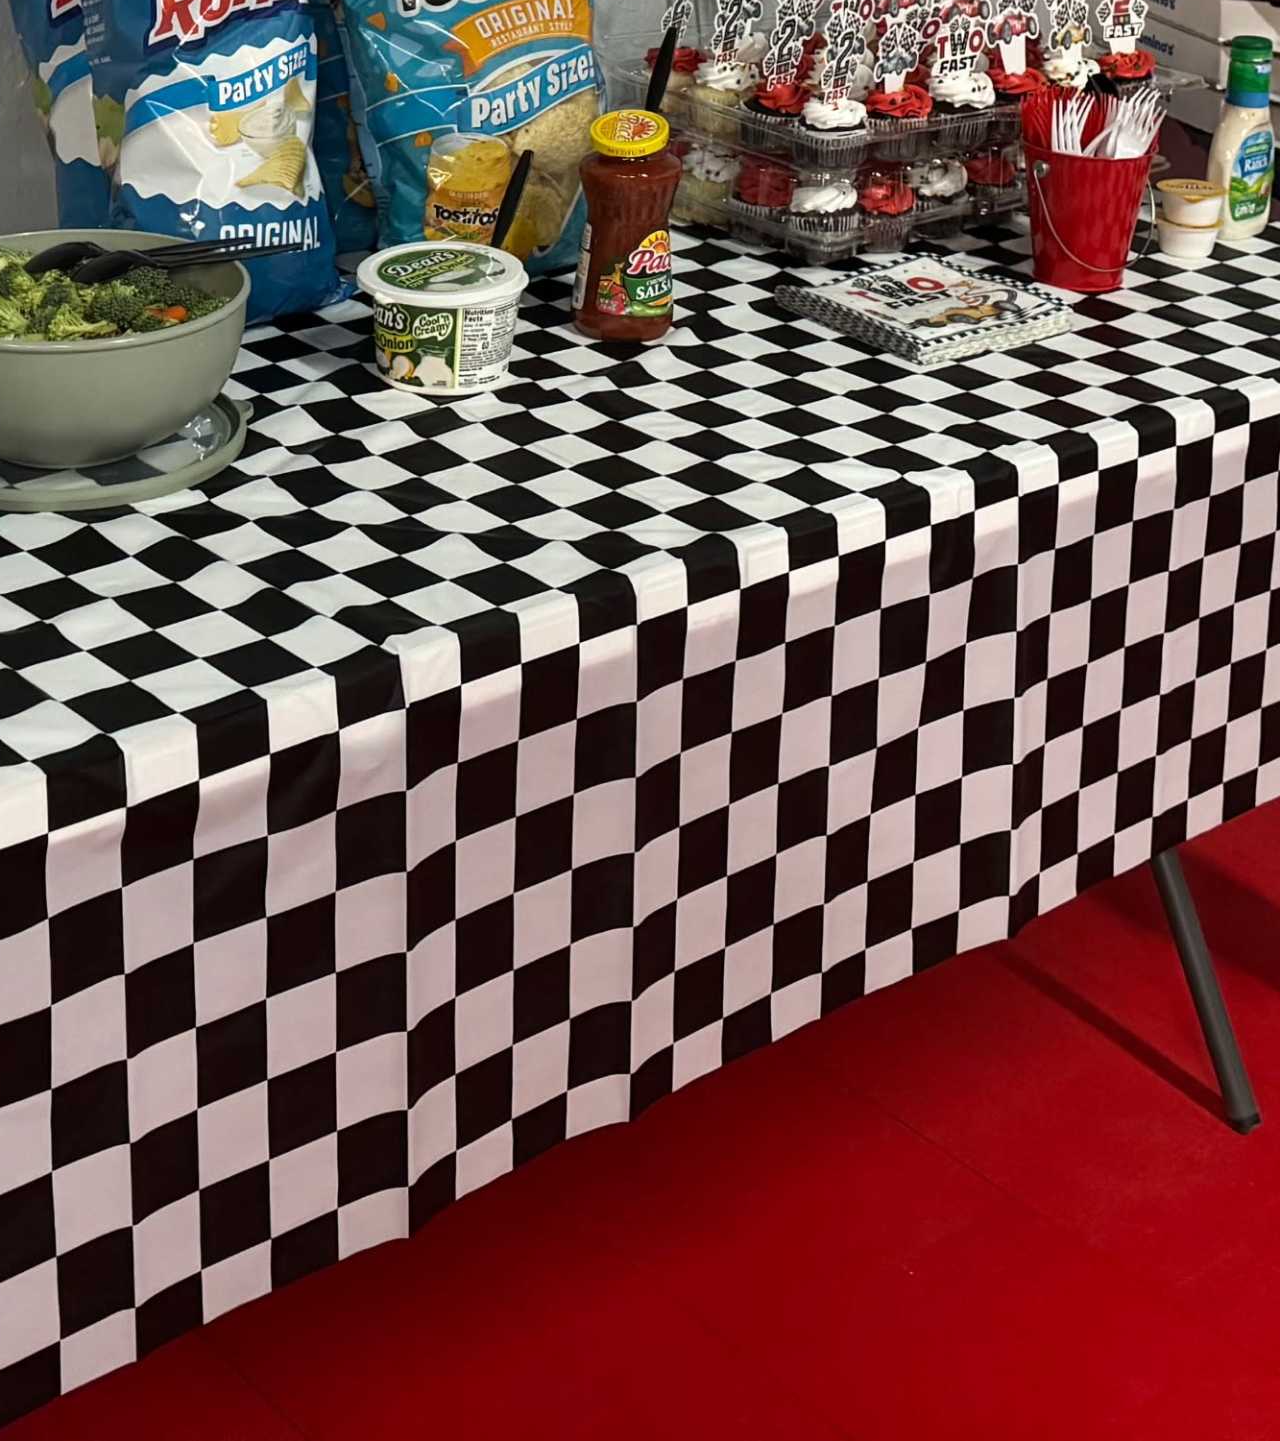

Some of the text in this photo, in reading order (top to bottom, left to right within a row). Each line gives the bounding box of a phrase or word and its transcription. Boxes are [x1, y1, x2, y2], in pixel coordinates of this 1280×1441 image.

[1106, 23, 1143, 38] FAST
[937, 29, 983, 59] TWO
[939, 55, 977, 74] FAST
[218, 65, 274, 106] Party
[471, 50, 595, 129] Party Size!
[883, 288, 952, 311] FAST
[414, 321, 451, 337] Creamy
[419, 314, 440, 327] Cool
